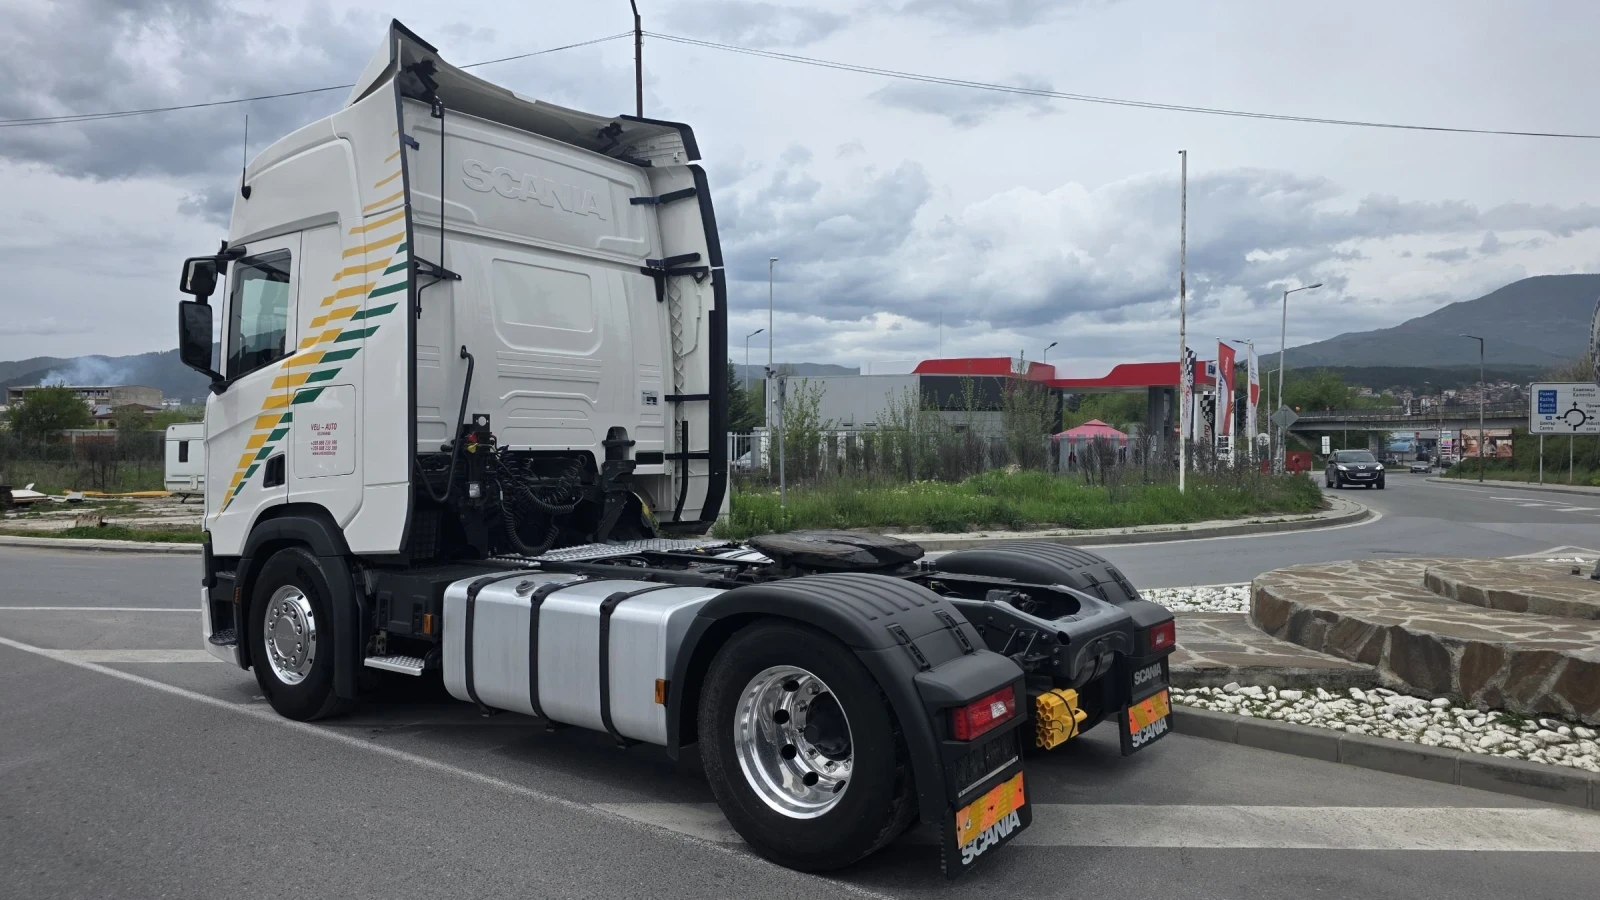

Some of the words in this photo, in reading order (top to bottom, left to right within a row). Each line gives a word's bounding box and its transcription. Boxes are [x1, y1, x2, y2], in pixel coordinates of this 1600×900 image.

[461, 159, 606, 221] SCANIA
[324, 422, 338, 430] AUTO
[1134, 662, 1162, 685] SCANIA
[1132, 717, 1168, 748] SCANIA
[961, 809, 1021, 865] SCANIA
